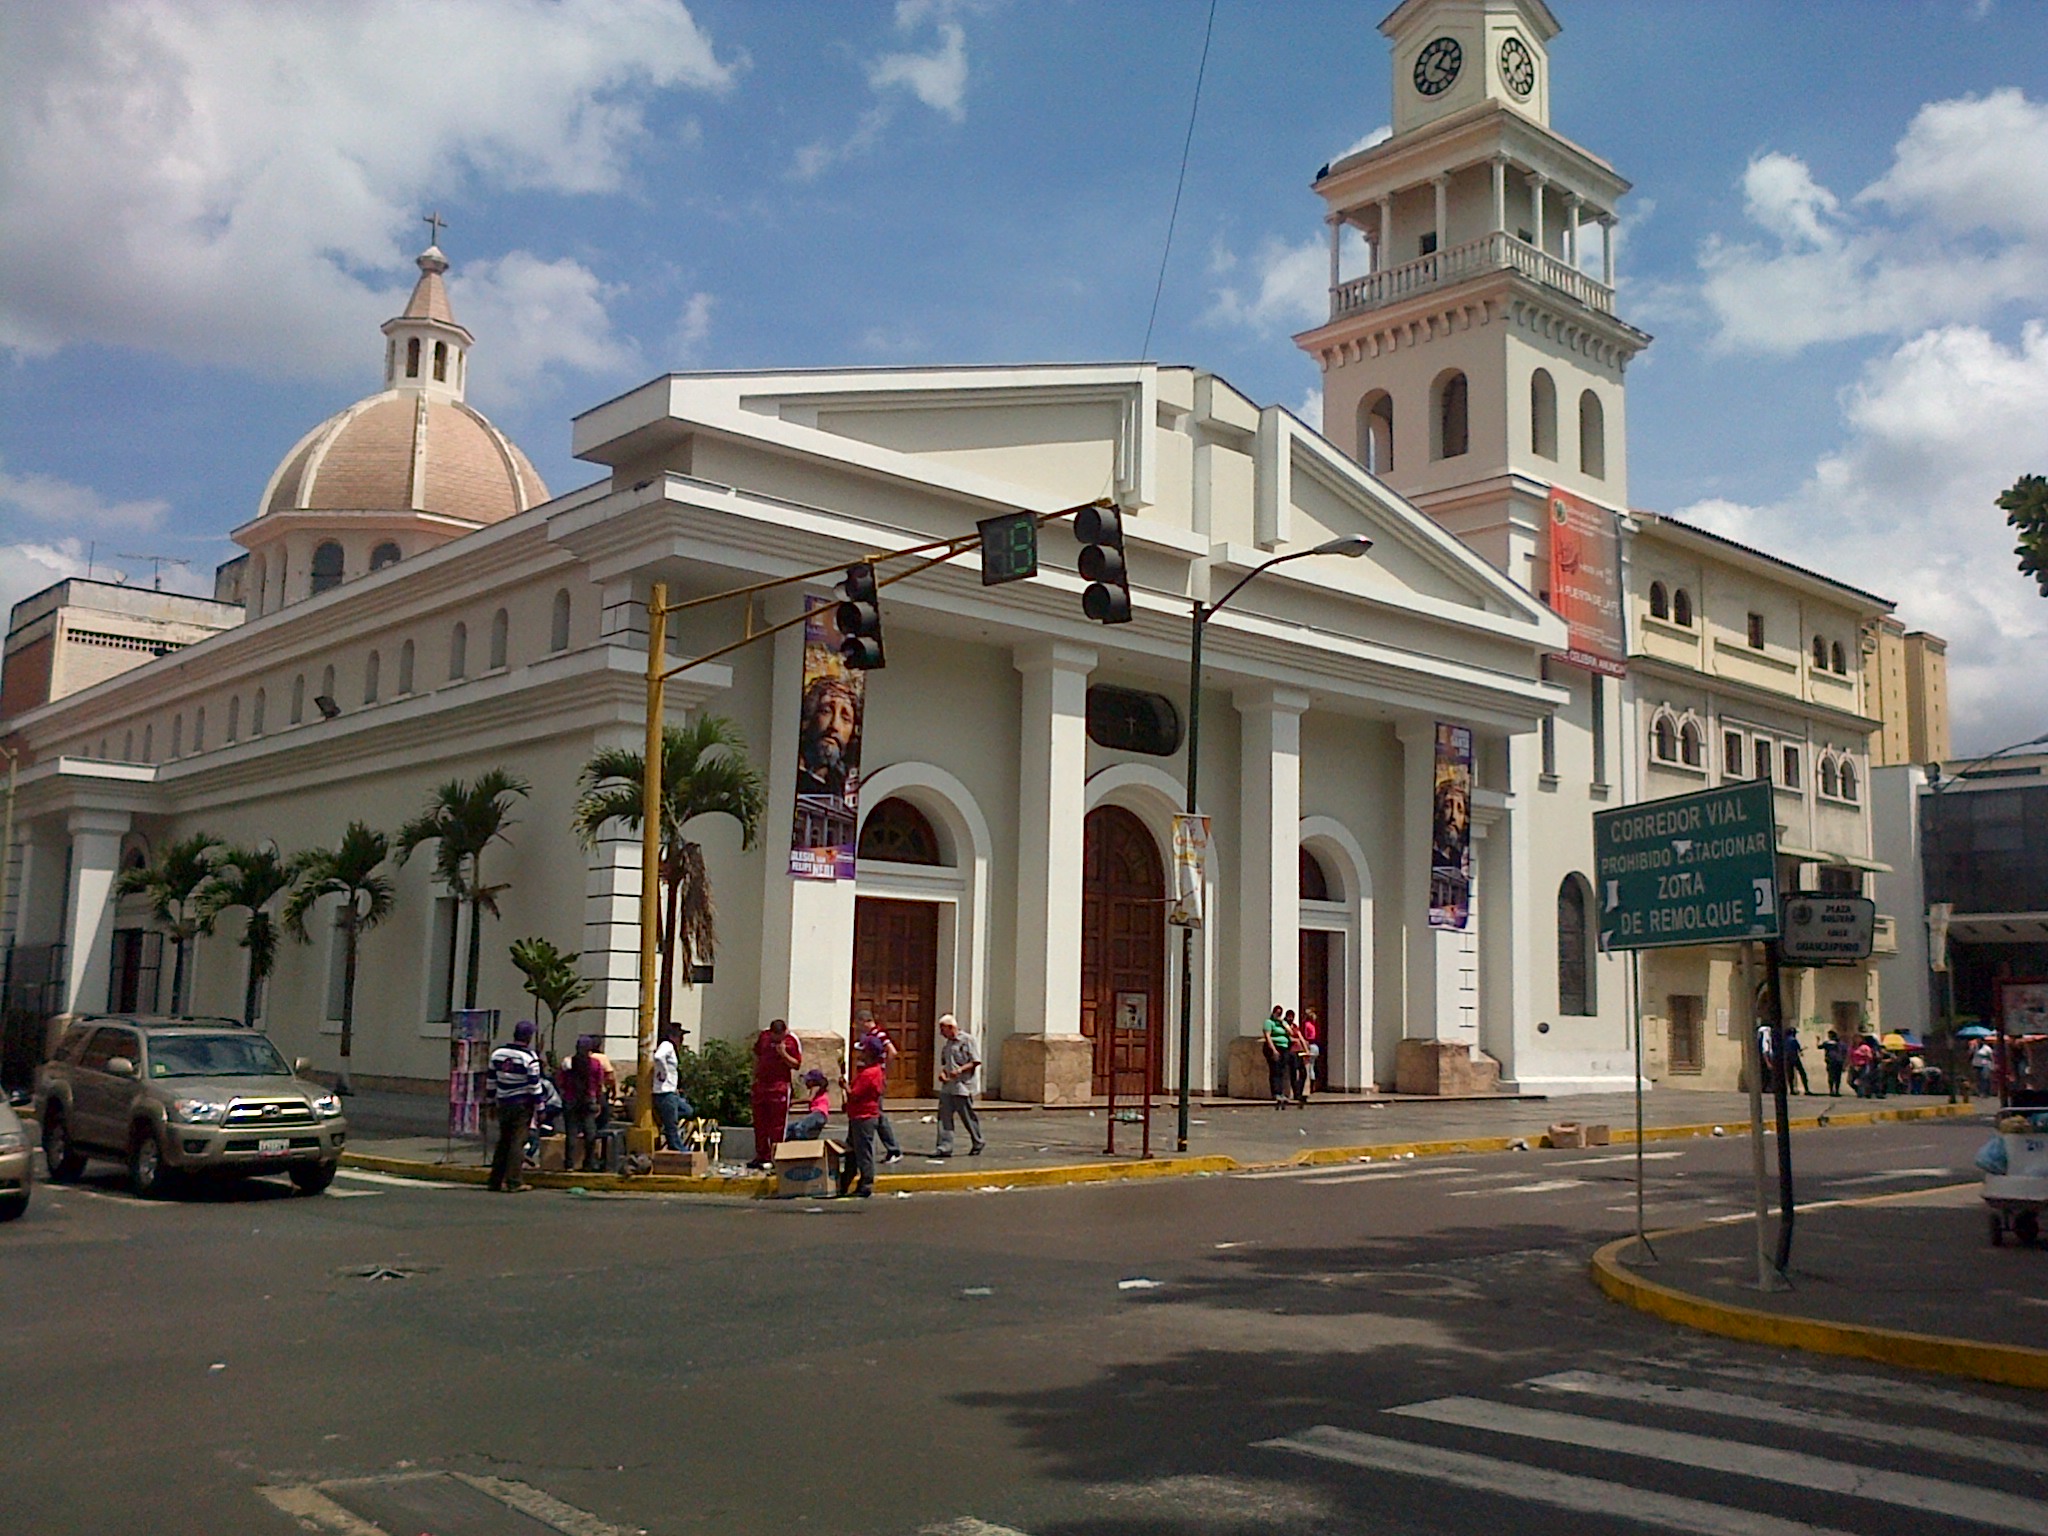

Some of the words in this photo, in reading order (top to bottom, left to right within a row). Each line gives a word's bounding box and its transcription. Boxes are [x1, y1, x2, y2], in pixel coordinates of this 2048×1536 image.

[1611, 806, 1700, 842] CORREDOR
[1706, 797, 1747, 826] VIAL
[1602, 848, 1671, 874] PROHIBIDO
[1657, 872, 1705, 900] ZONA
[1621, 911, 1643, 935] DE
[1651, 900, 1744, 932] REMOLQUE
[1826, 905, 1851, 913] PLAZA
